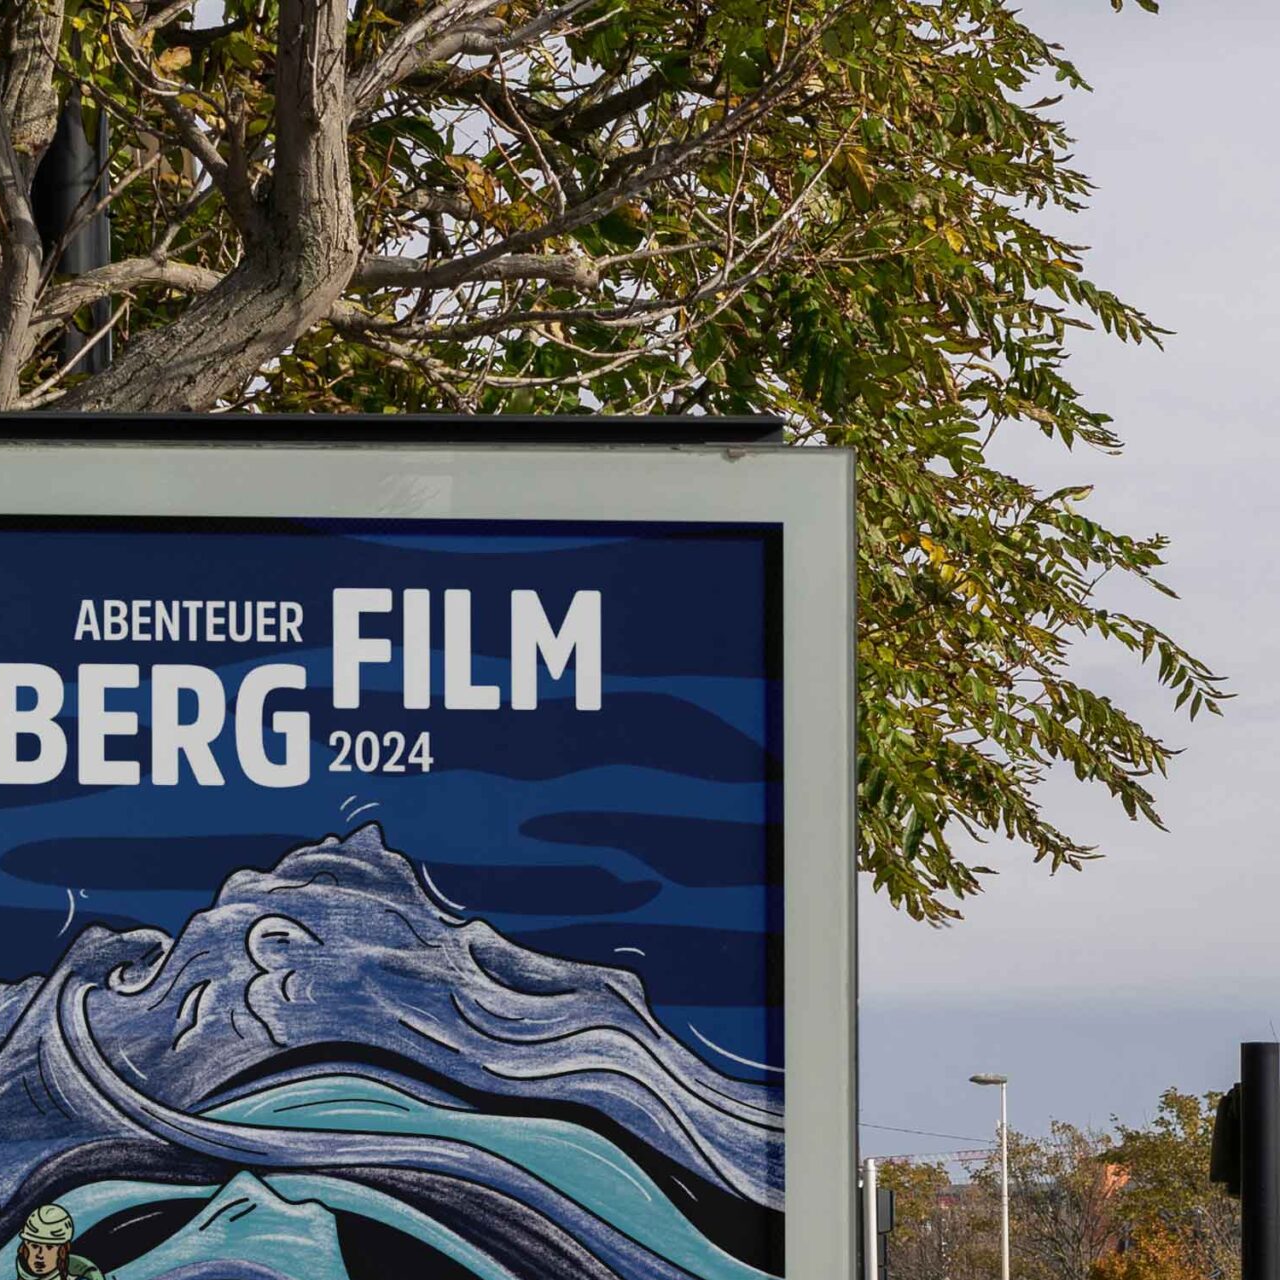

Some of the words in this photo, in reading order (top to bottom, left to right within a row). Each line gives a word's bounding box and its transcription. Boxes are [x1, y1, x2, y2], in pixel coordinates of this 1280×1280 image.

[74, 599, 303, 643] ABENTEUER
[332, 588, 602, 711] FILM
[328, 731, 434, 773] 2024
